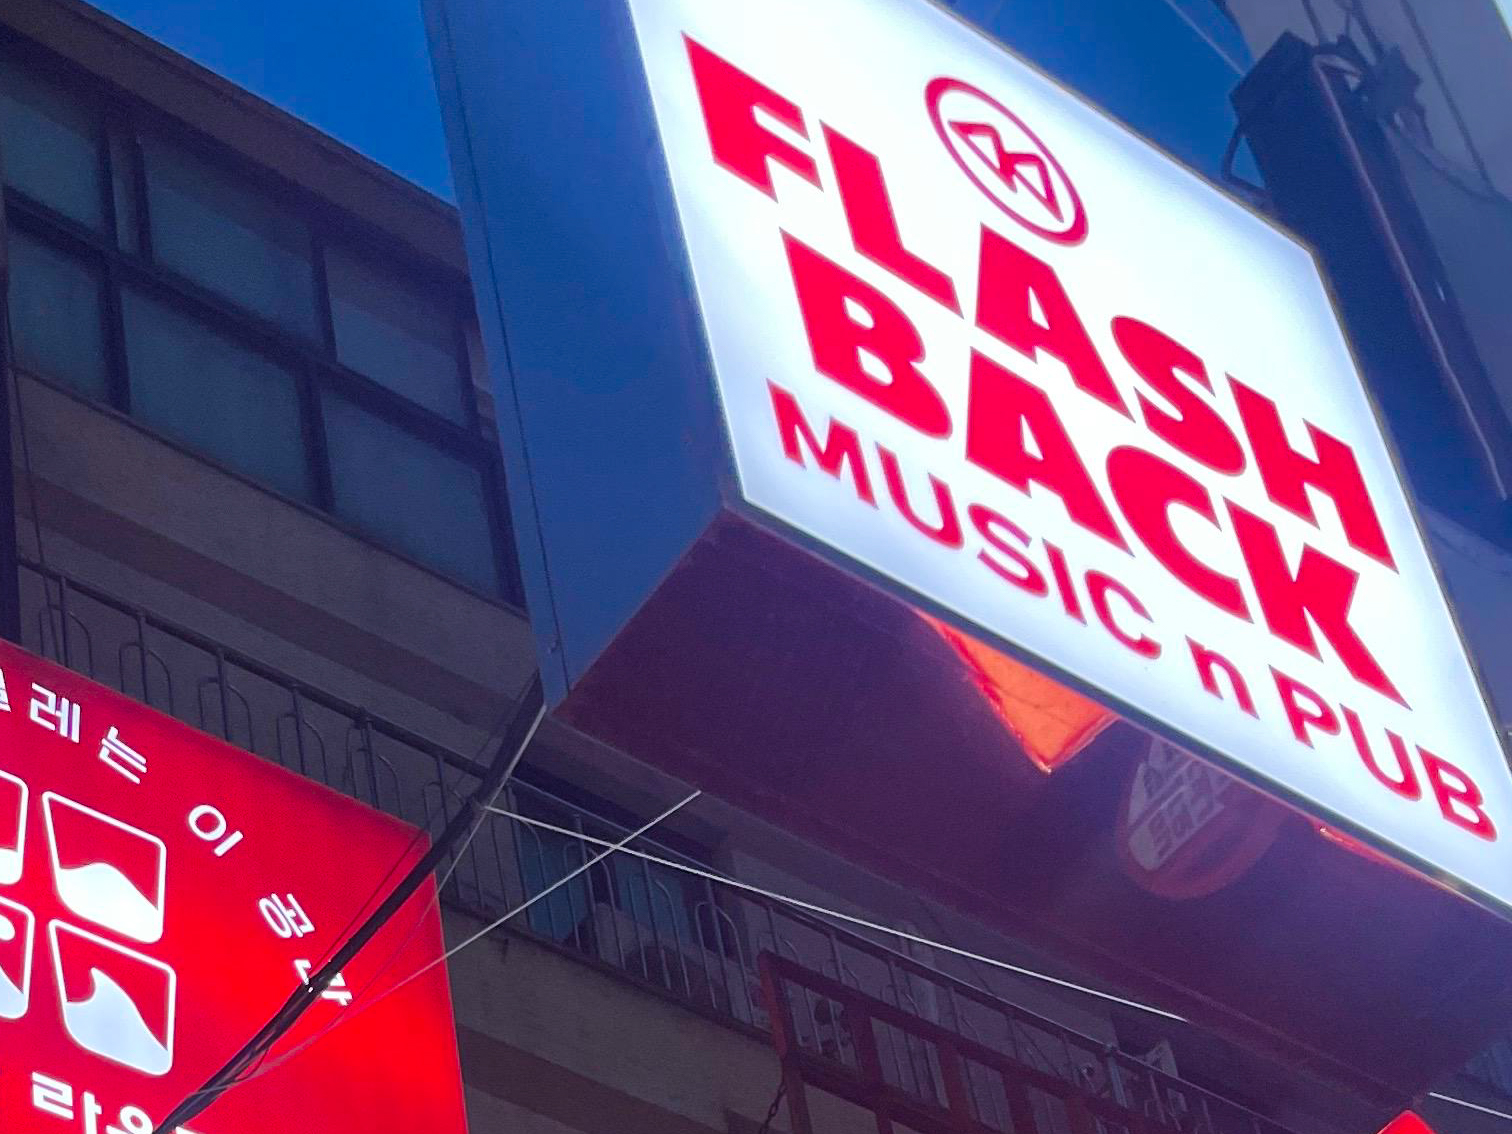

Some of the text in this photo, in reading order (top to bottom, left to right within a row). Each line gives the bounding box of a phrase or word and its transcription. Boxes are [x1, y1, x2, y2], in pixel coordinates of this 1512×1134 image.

[680, 29, 1399, 575] FLASH
[778, 226, 1412, 711] BACK
[187, 803, 244, 858] 이
[765, 377, 1162, 660] MUSIC
[1185, 634, 1260, 720] n
[1267, 663, 1498, 843] PUB
